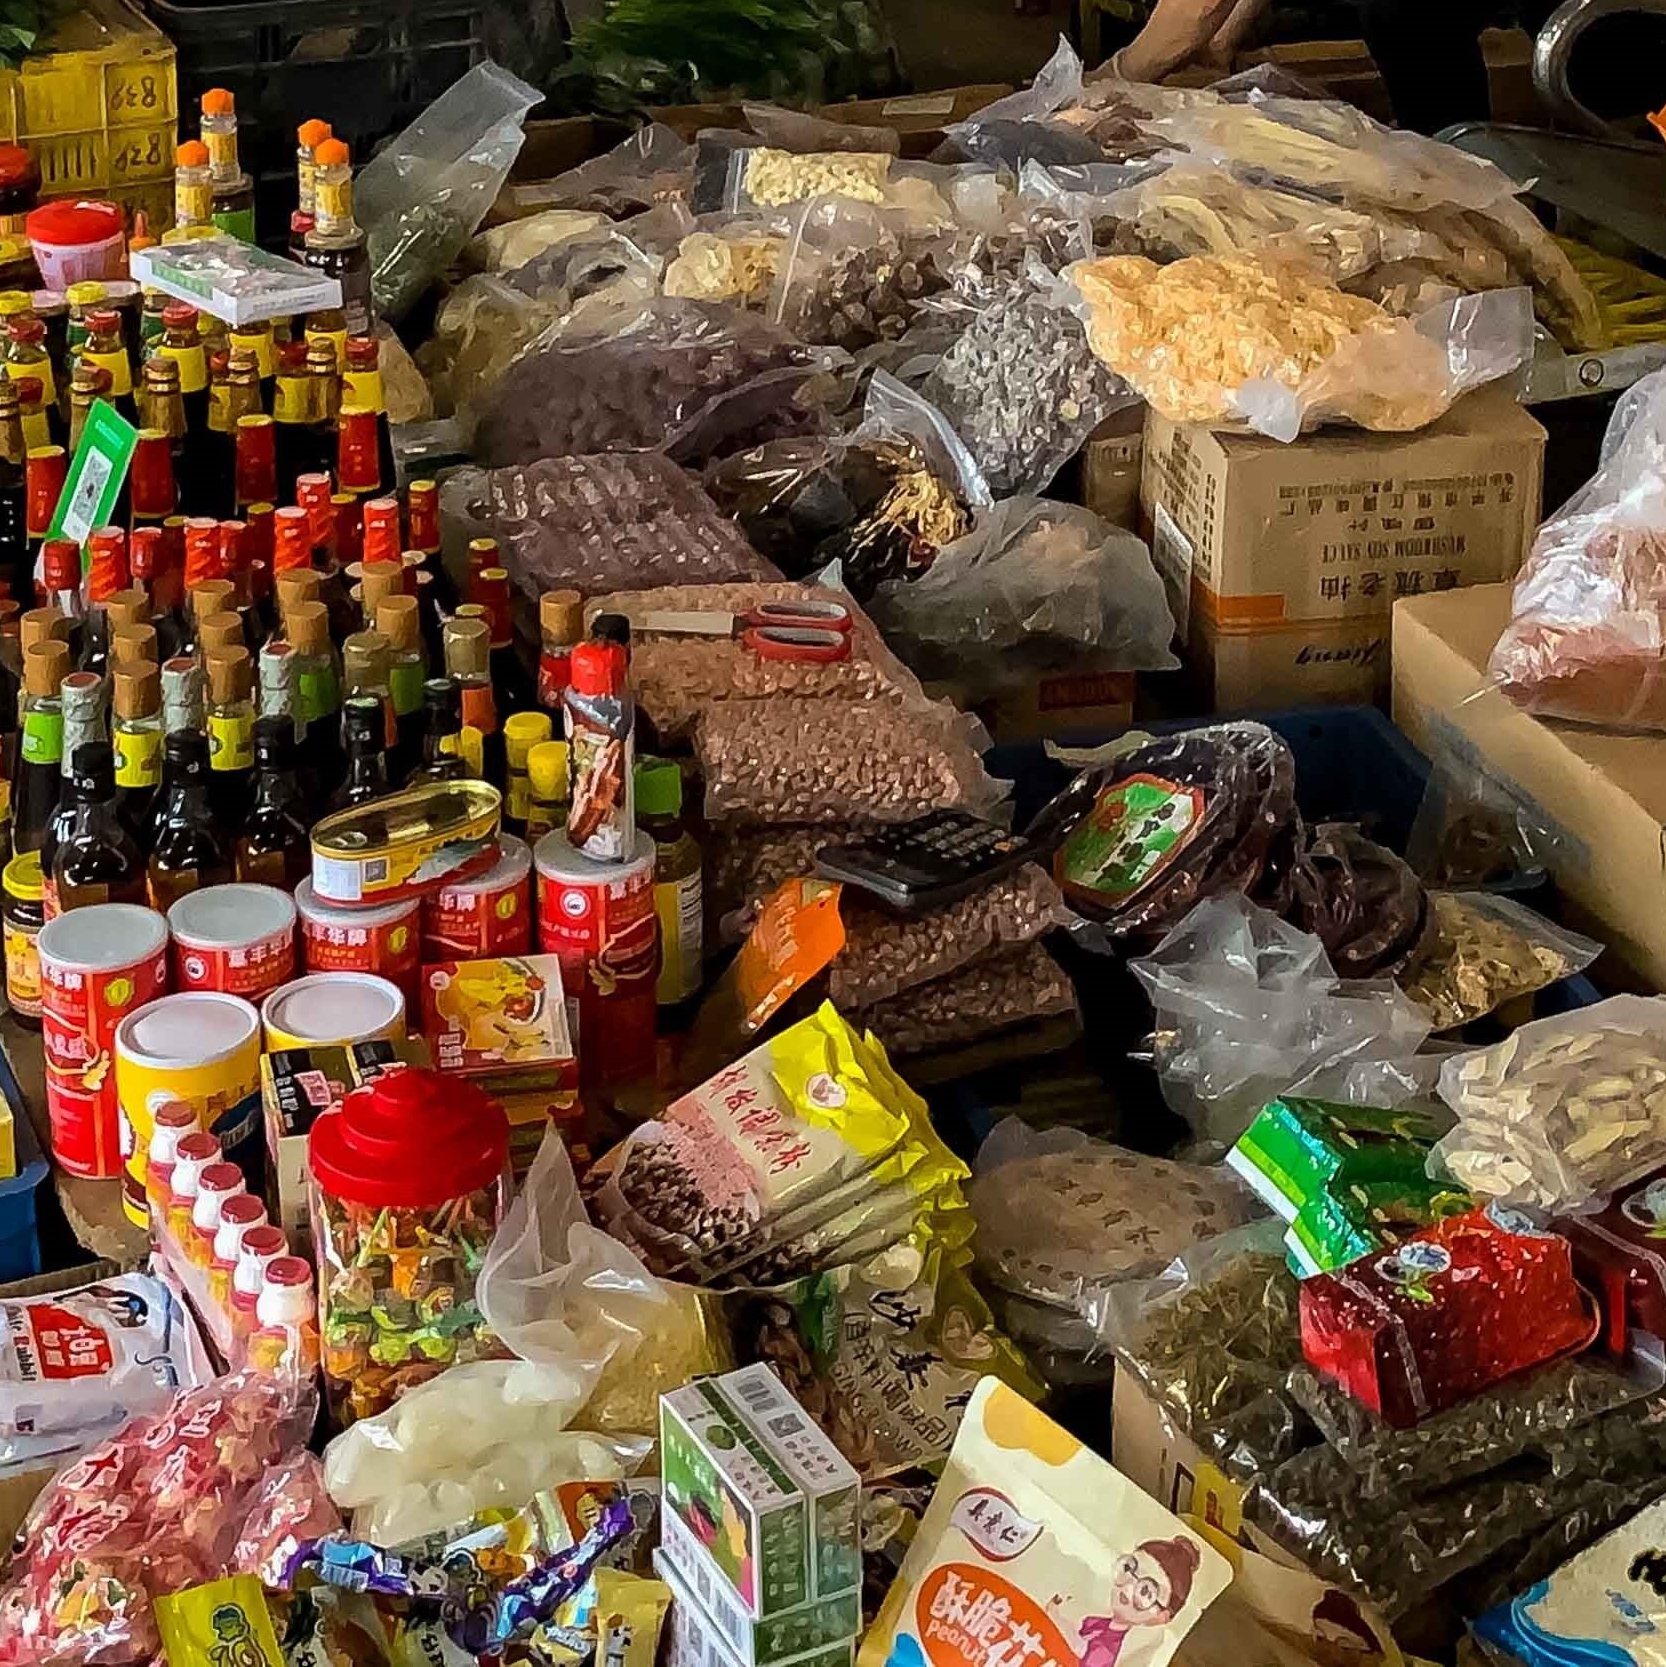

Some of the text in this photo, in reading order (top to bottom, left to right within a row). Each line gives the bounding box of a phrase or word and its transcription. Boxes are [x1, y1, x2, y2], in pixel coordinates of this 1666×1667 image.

[1321, 541, 1363, 565] SAUCE
[1366, 540, 1391, 561] SOY
[930, 1570, 1079, 1667] 酥脆花
